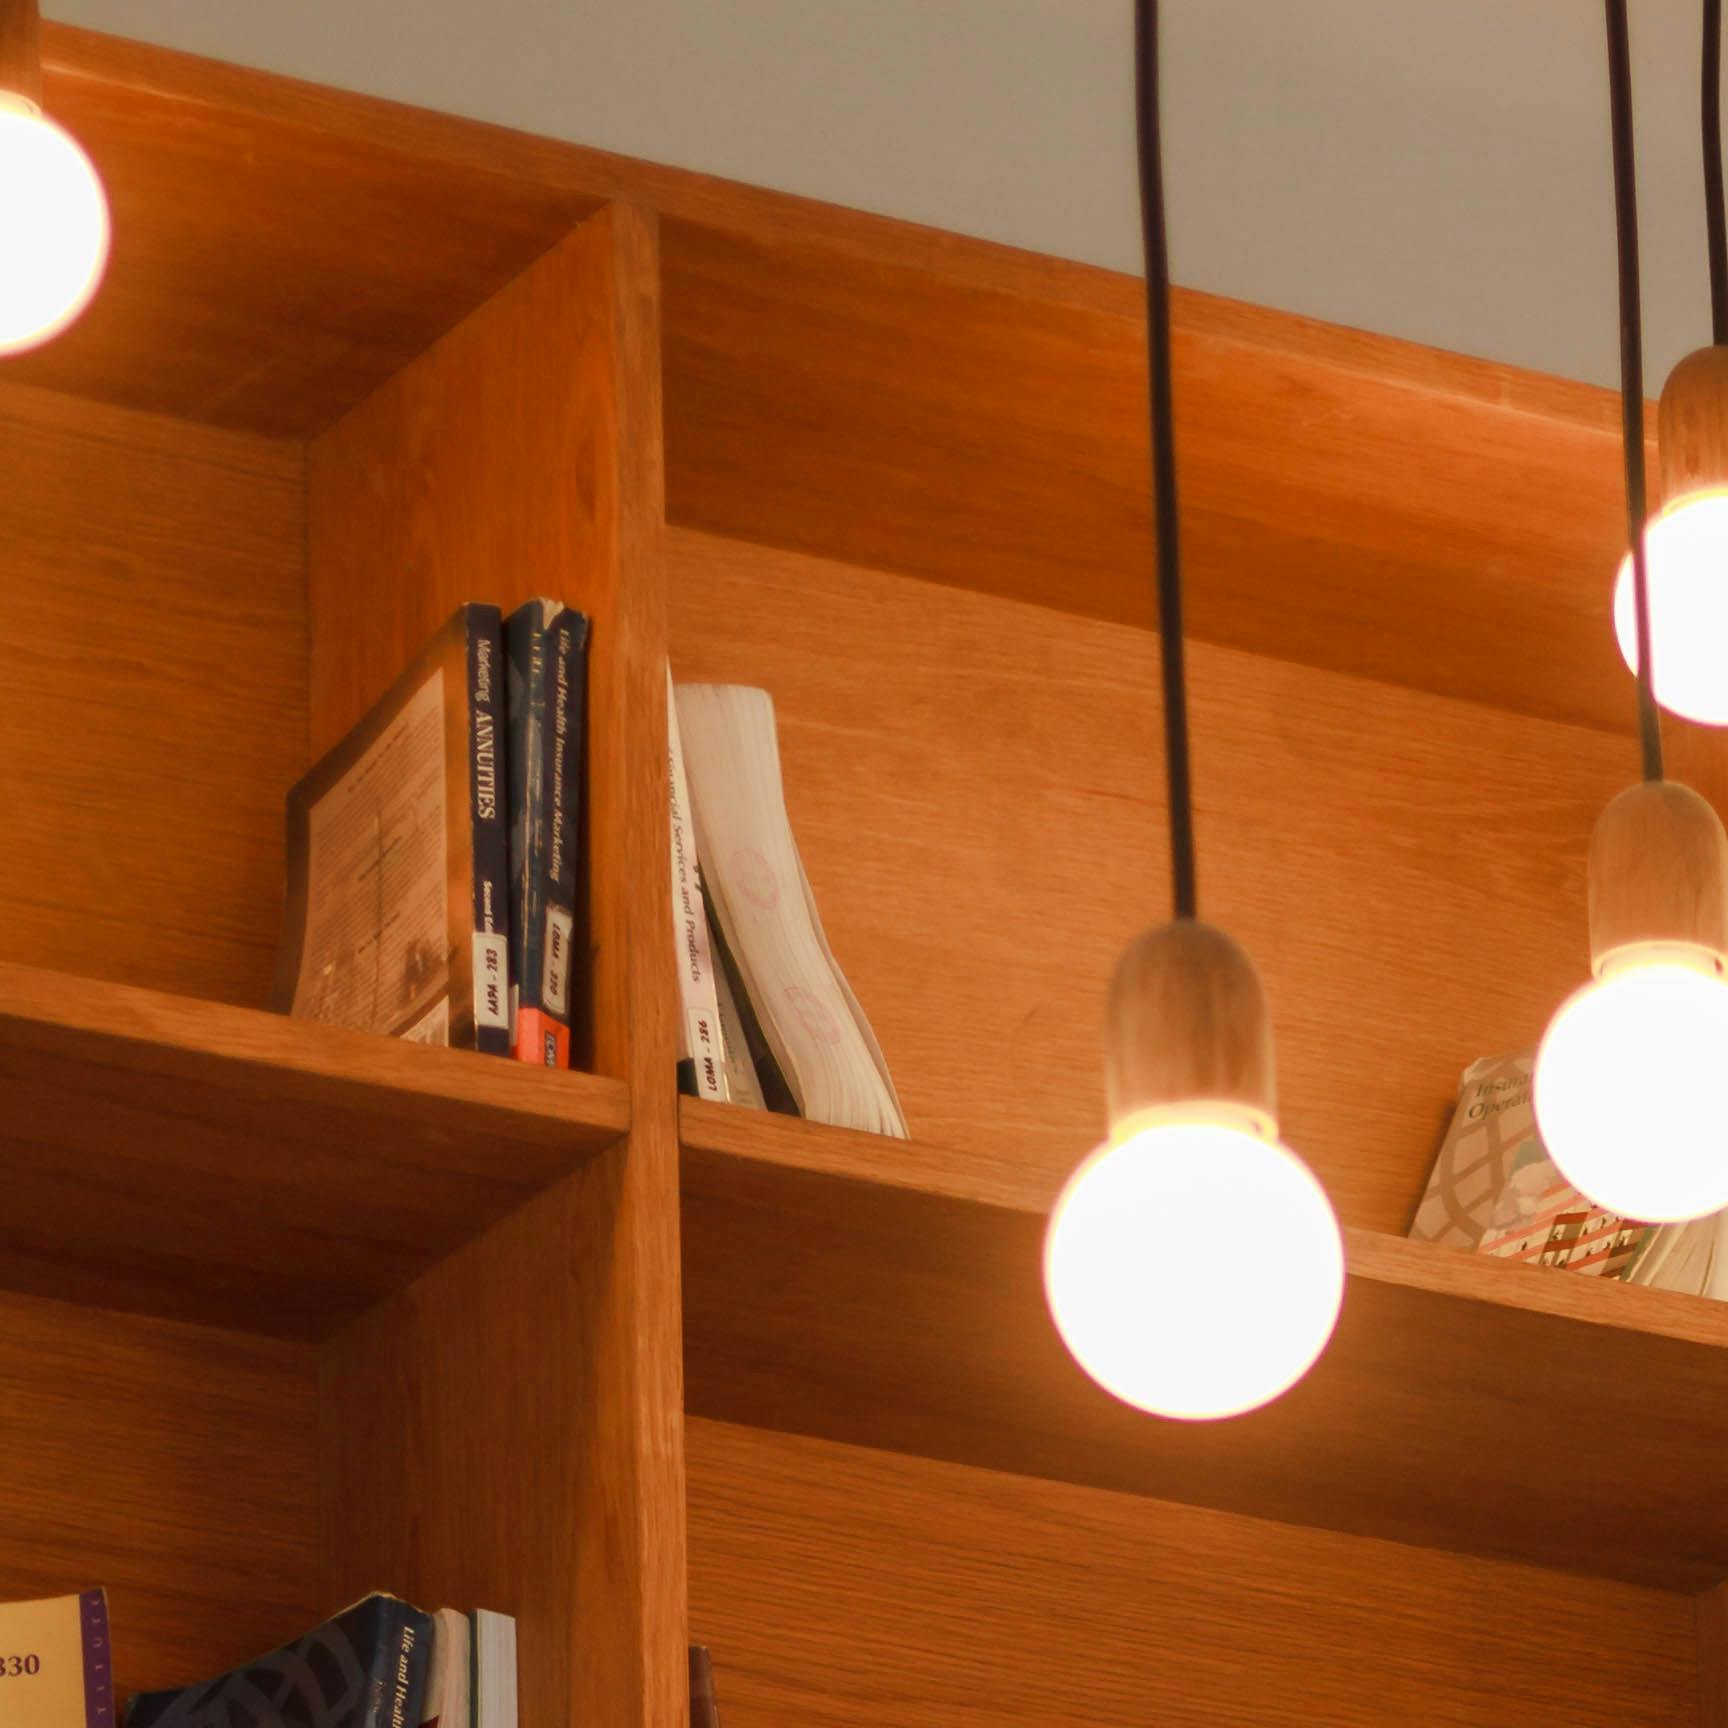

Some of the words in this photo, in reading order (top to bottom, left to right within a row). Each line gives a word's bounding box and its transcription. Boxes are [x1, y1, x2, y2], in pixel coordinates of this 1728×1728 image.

[474, 638, 492, 703] Marketing
[475, 709, 496, 820] ANNUITIES
[699, 1019, 711, 1045] 286
[704, 1057, 718, 1093] LOMA
[402, 1626, 415, 1655] Life
[399, 1655, 410, 1683] and
